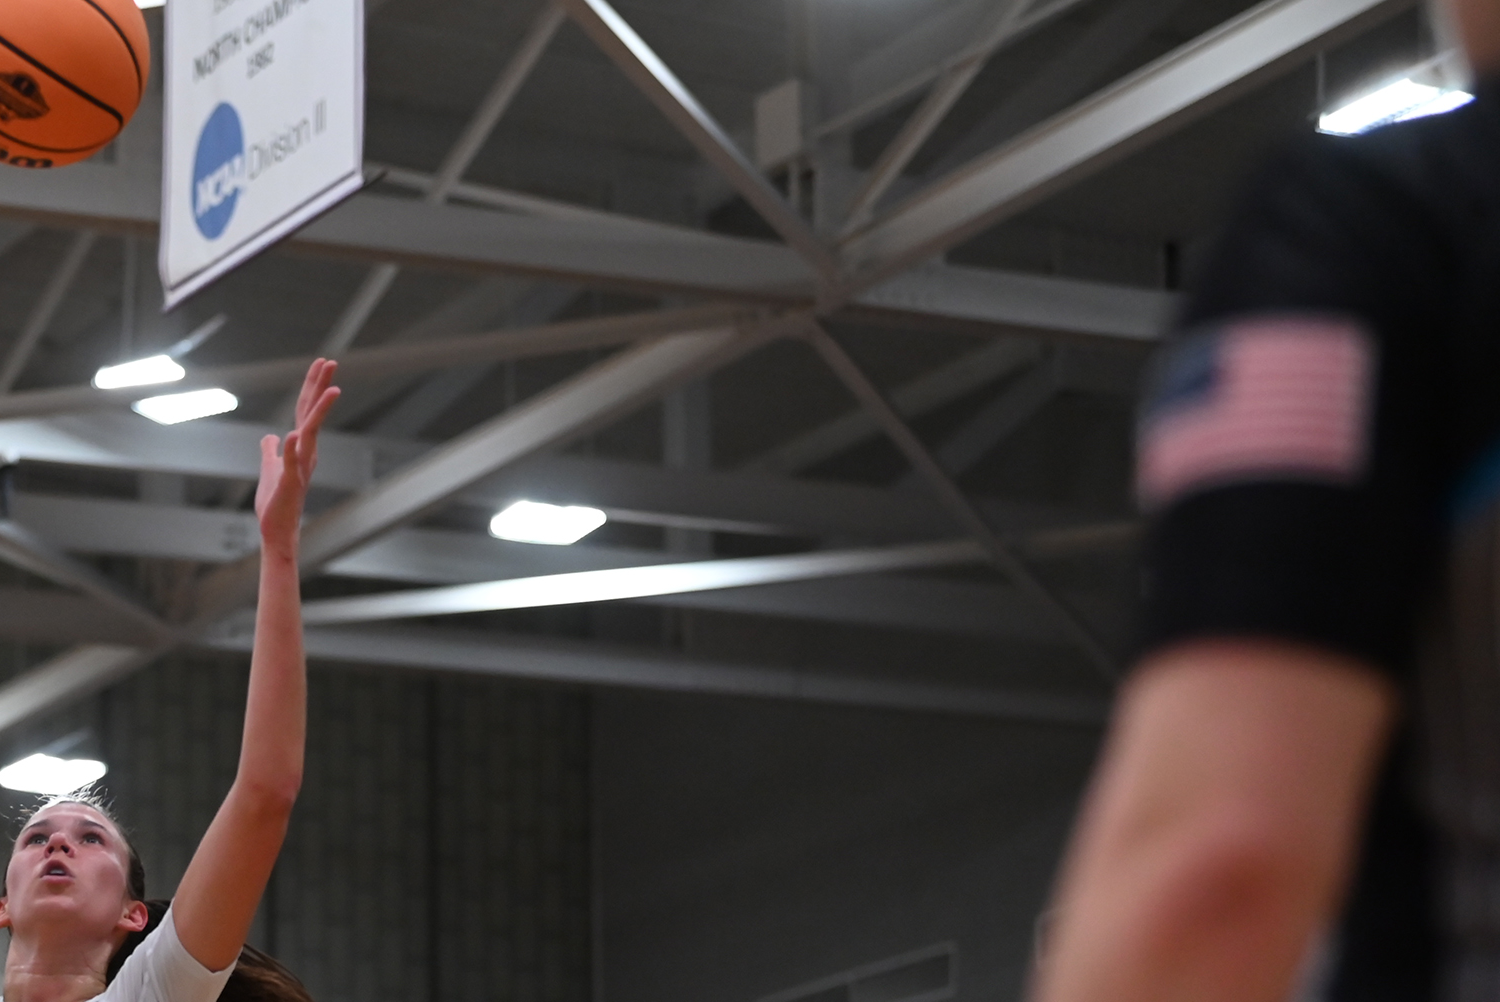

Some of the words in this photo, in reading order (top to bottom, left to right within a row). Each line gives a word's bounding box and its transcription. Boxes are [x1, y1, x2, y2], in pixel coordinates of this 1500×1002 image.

[193, 27, 242, 84] NORTH
[196, 152, 245, 219] NCAA
[248, 117, 311, 180] Division
